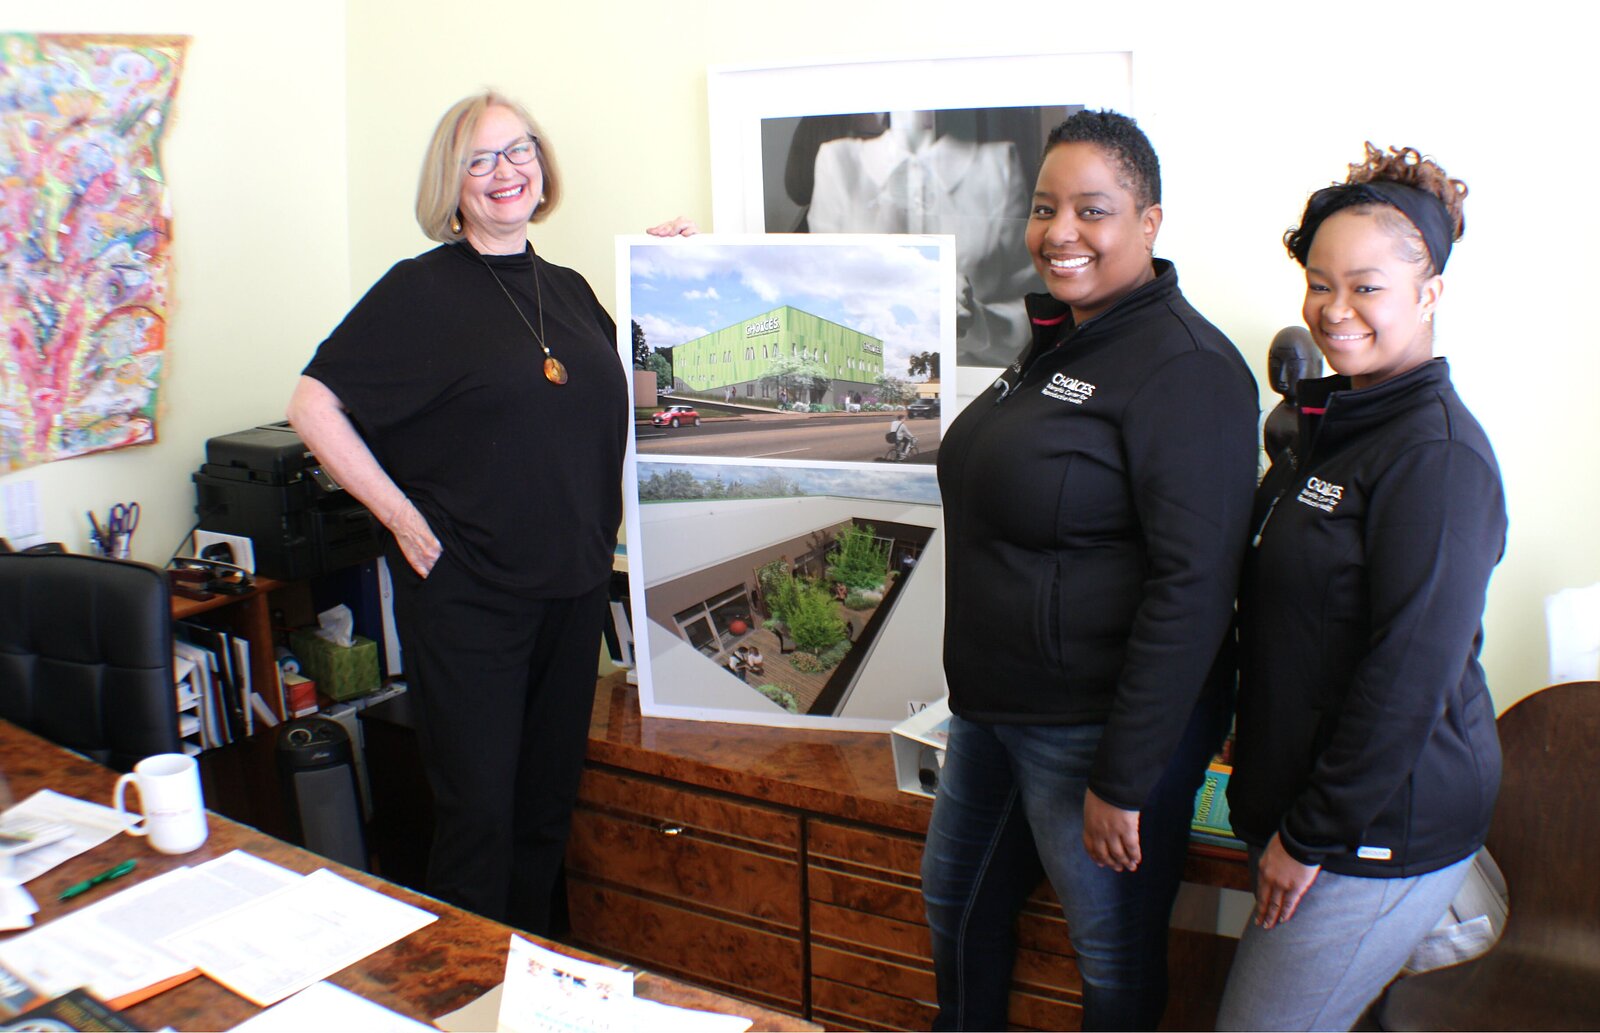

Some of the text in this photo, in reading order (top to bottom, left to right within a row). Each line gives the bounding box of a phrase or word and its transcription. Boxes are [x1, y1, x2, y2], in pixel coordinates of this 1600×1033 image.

[745, 317, 780, 336] CHOICES
[1052, 372, 1096, 397] CHOICES
[1306, 476, 1345, 500] CHOICES
